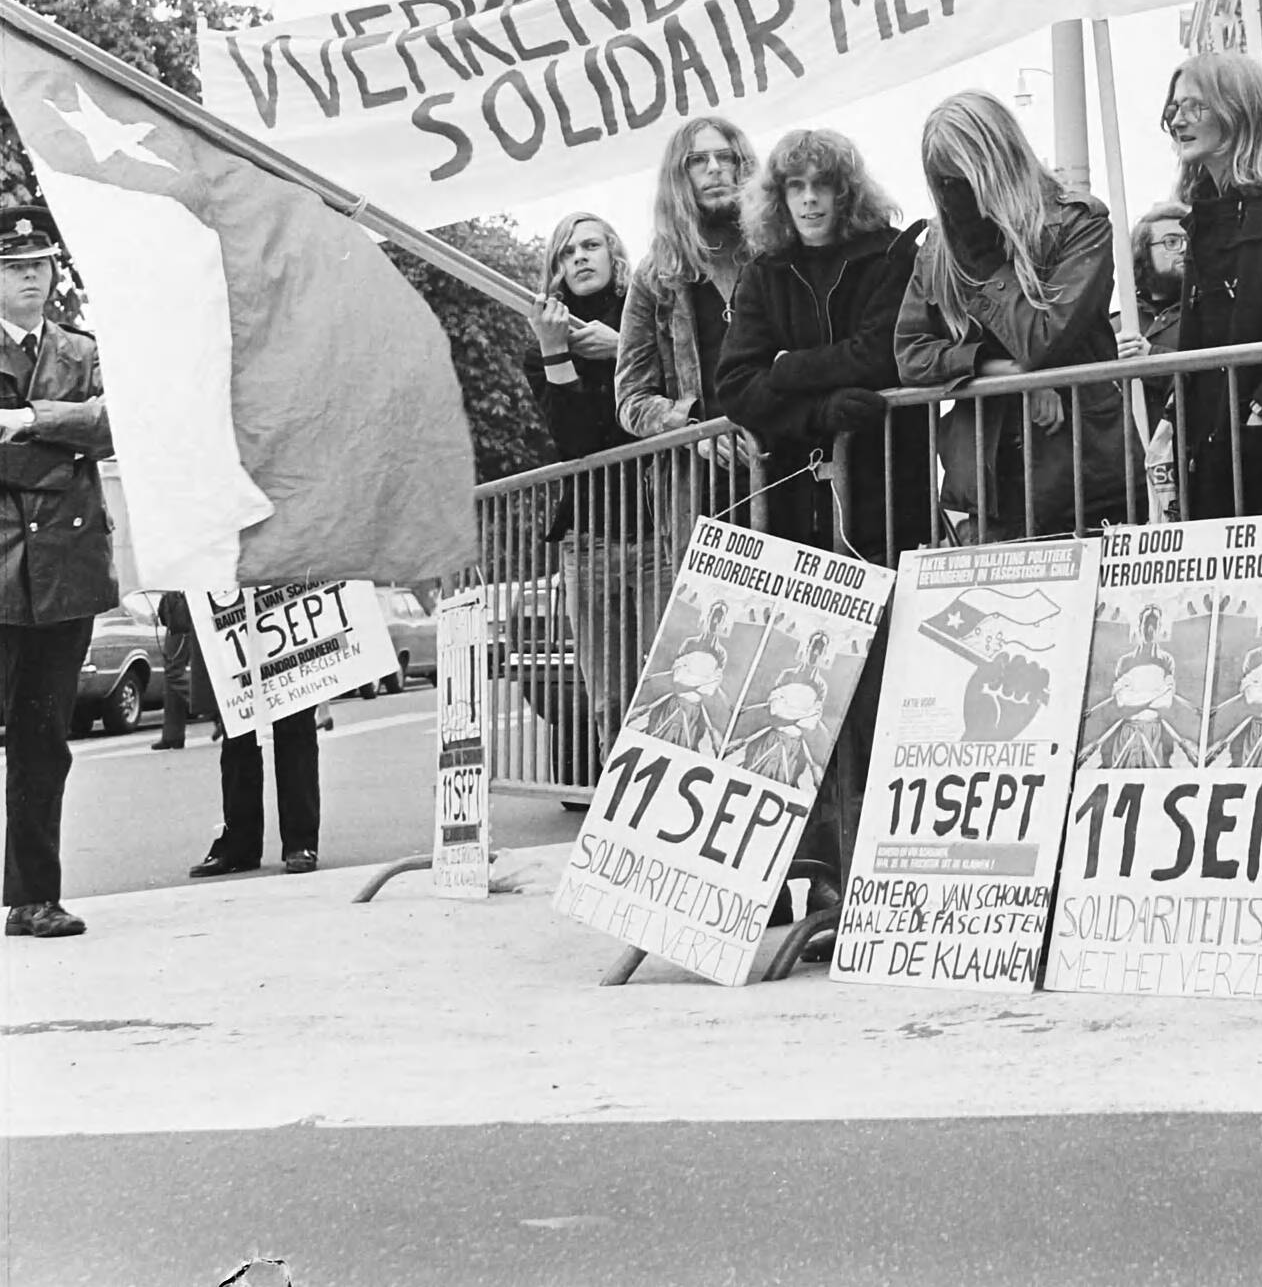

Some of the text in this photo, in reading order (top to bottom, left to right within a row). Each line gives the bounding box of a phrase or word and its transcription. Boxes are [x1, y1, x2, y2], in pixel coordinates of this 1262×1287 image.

[697, 524, 764, 560] TER DOOD
[1102, 529, 1184, 558] TER DOOD
[1225, 524, 1256, 549] TER
[687, 549, 784, 596] VEROORDEELD
[794, 550, 866, 590] TER DOOD
[1099, 556, 1217, 588] VEROORDEELD
[262, 590, 284, 608] VAN
[256, 581, 349, 658] SEPT
[298, 638, 340, 667] ROMERO
[262, 678, 278, 694] ZE
[280, 672, 296, 687] DE
[239, 704, 254, 720] UI
[268, 694, 285, 710] DE
[895, 742, 1037, 768] DEMONSTRATIE
[604, 746, 809, 882] 11 SEPT
[888, 772, 1046, 841] 11 SEPT
[1075, 783, 1145, 879] 11
[571, 834, 768, 942] SOLIDARITEITSDAG
[849, 876, 1050, 913] ROMERO VAN SCHOUWEN
[555, 877, 752, 987] MET HET VERZET
[842, 908, 1046, 935] HAAL ZE DE FASCISTEN
[838, 940, 1041, 983] UIT DE KLAUWEN
[1054, 950, 1116, 990] MET
[1121, 951, 1171, 994] HET
